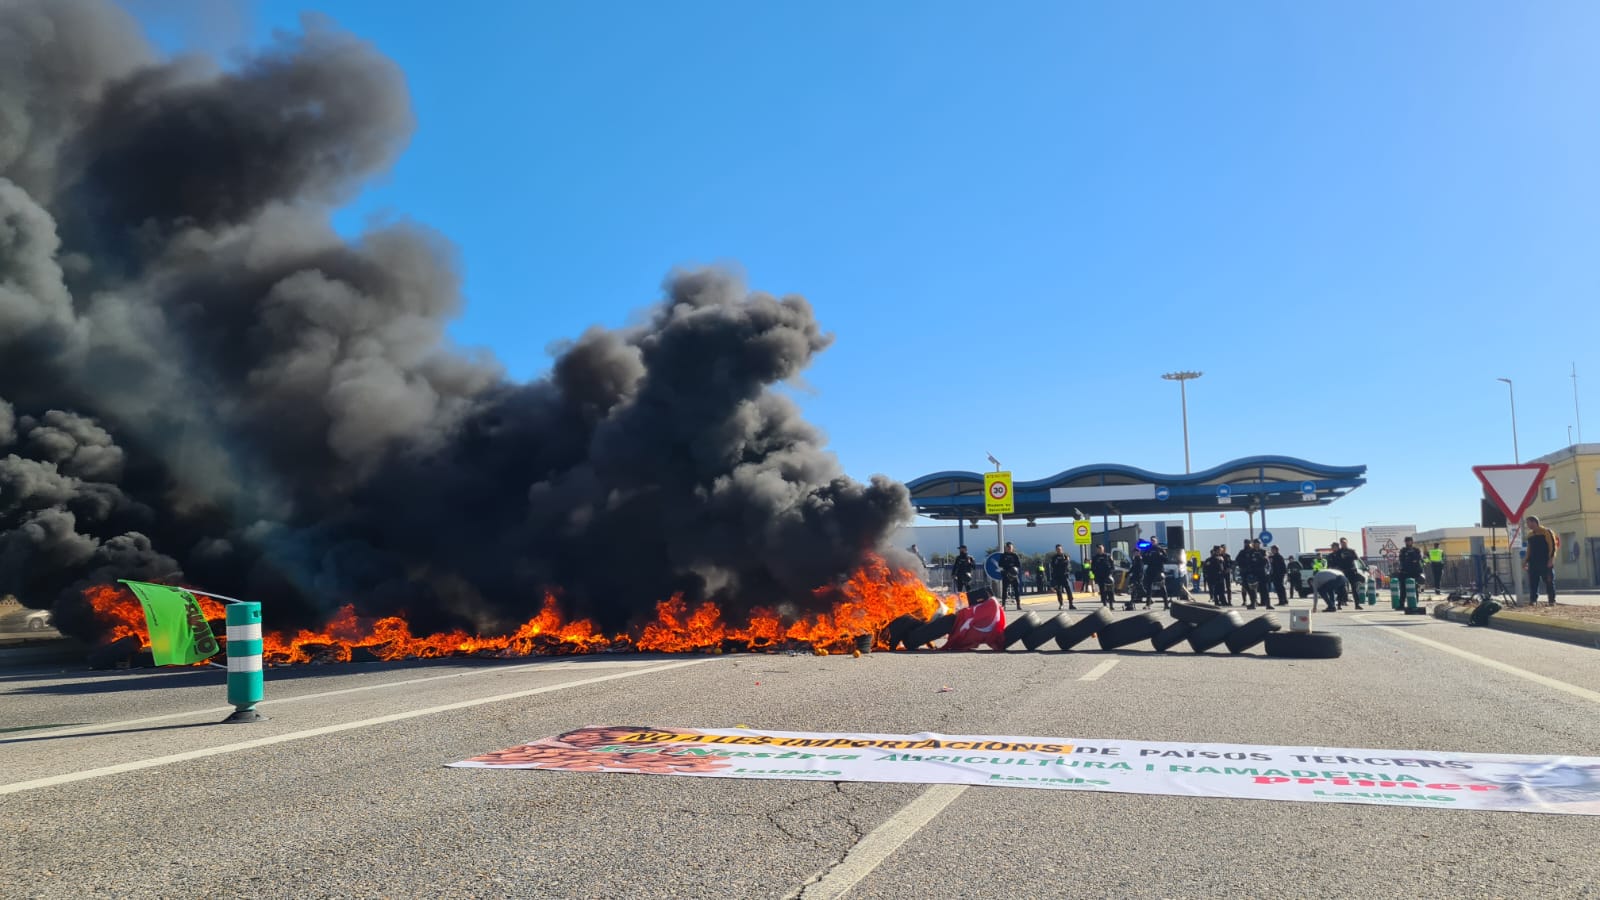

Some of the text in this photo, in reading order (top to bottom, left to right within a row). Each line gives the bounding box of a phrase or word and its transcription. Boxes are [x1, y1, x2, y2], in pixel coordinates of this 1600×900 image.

[624, 732, 1473, 769] NO A LES IMPORTACIONS DE PAÏSOS TERCERS
[672, 748, 863, 760] Nostra
[874, 753, 1133, 770] AGRICULTURA
[1145, 763, 1155, 771] I
[1168, 764, 1425, 783] RAMADERIA
[1253, 776, 1500, 791] primer
